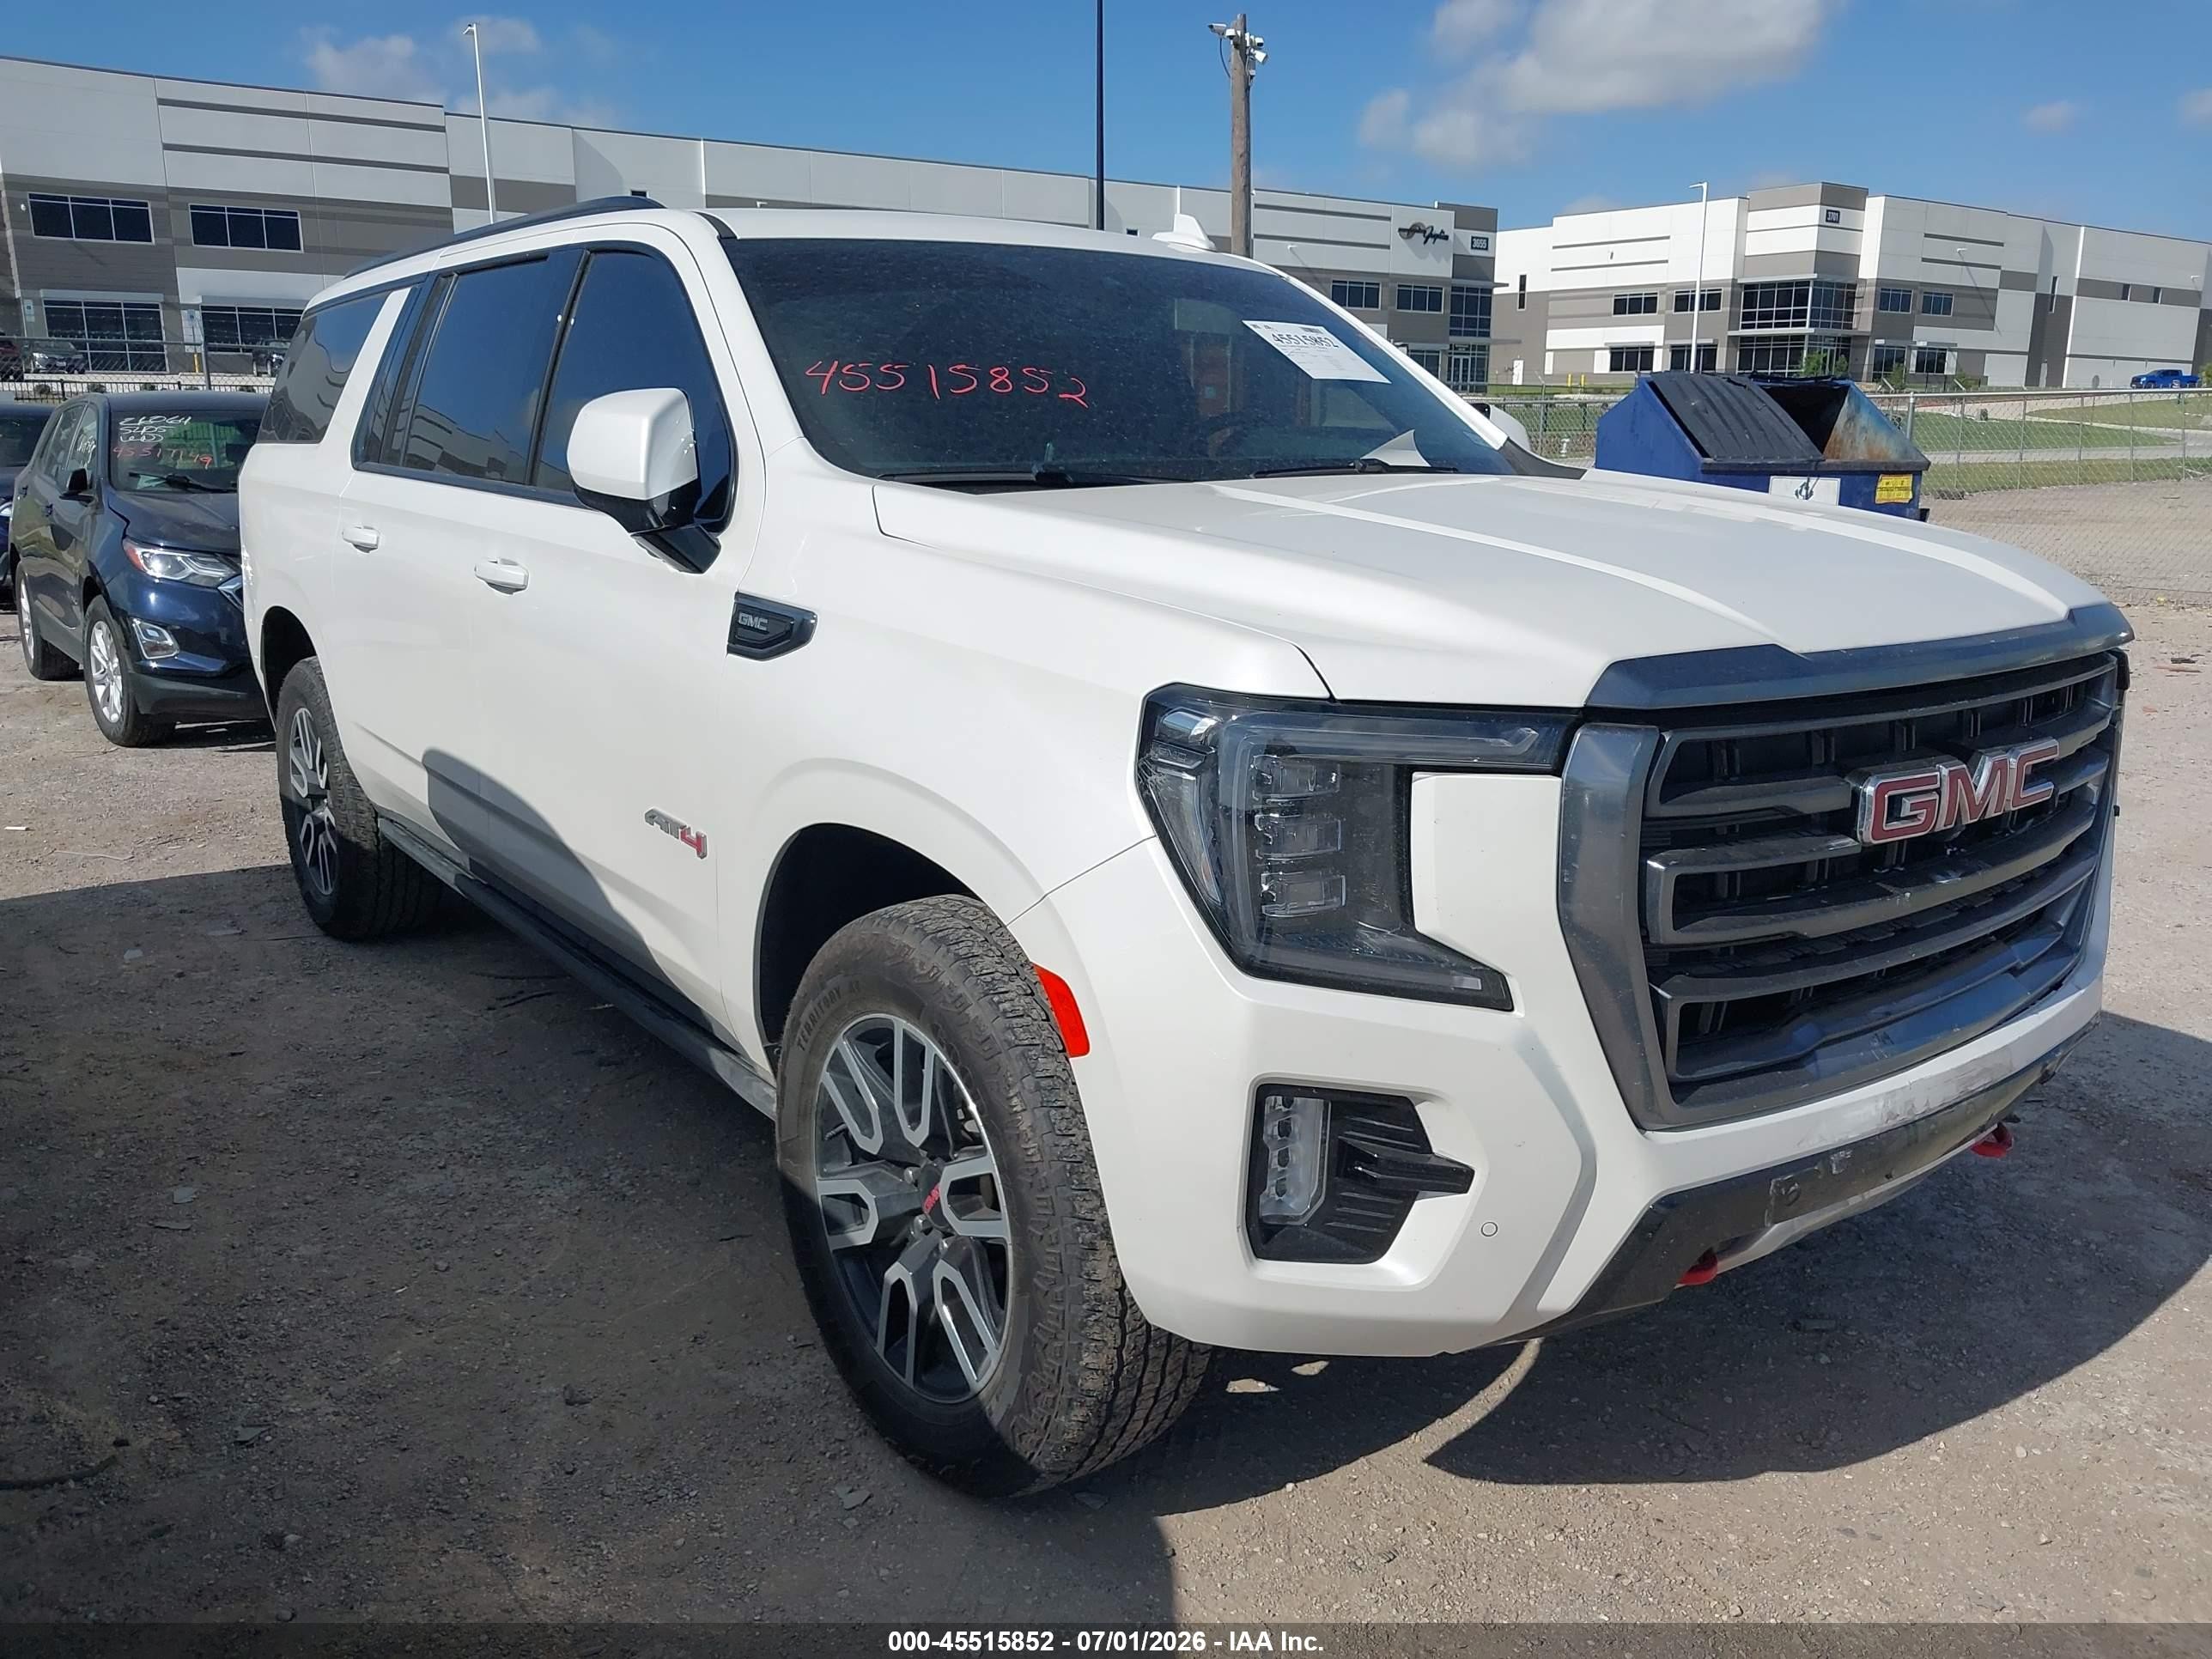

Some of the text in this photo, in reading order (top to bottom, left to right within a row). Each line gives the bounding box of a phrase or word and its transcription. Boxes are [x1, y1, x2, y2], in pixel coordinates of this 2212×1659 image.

[1271, 332, 1340, 348] 45515852
[805, 361, 1089, 409] 45515852
[738, 611, 769, 631] GMC
[1858, 737, 2059, 845] GMC
[645, 808, 708, 860] AT4
[796, 986, 842, 1052] TERRITORY
